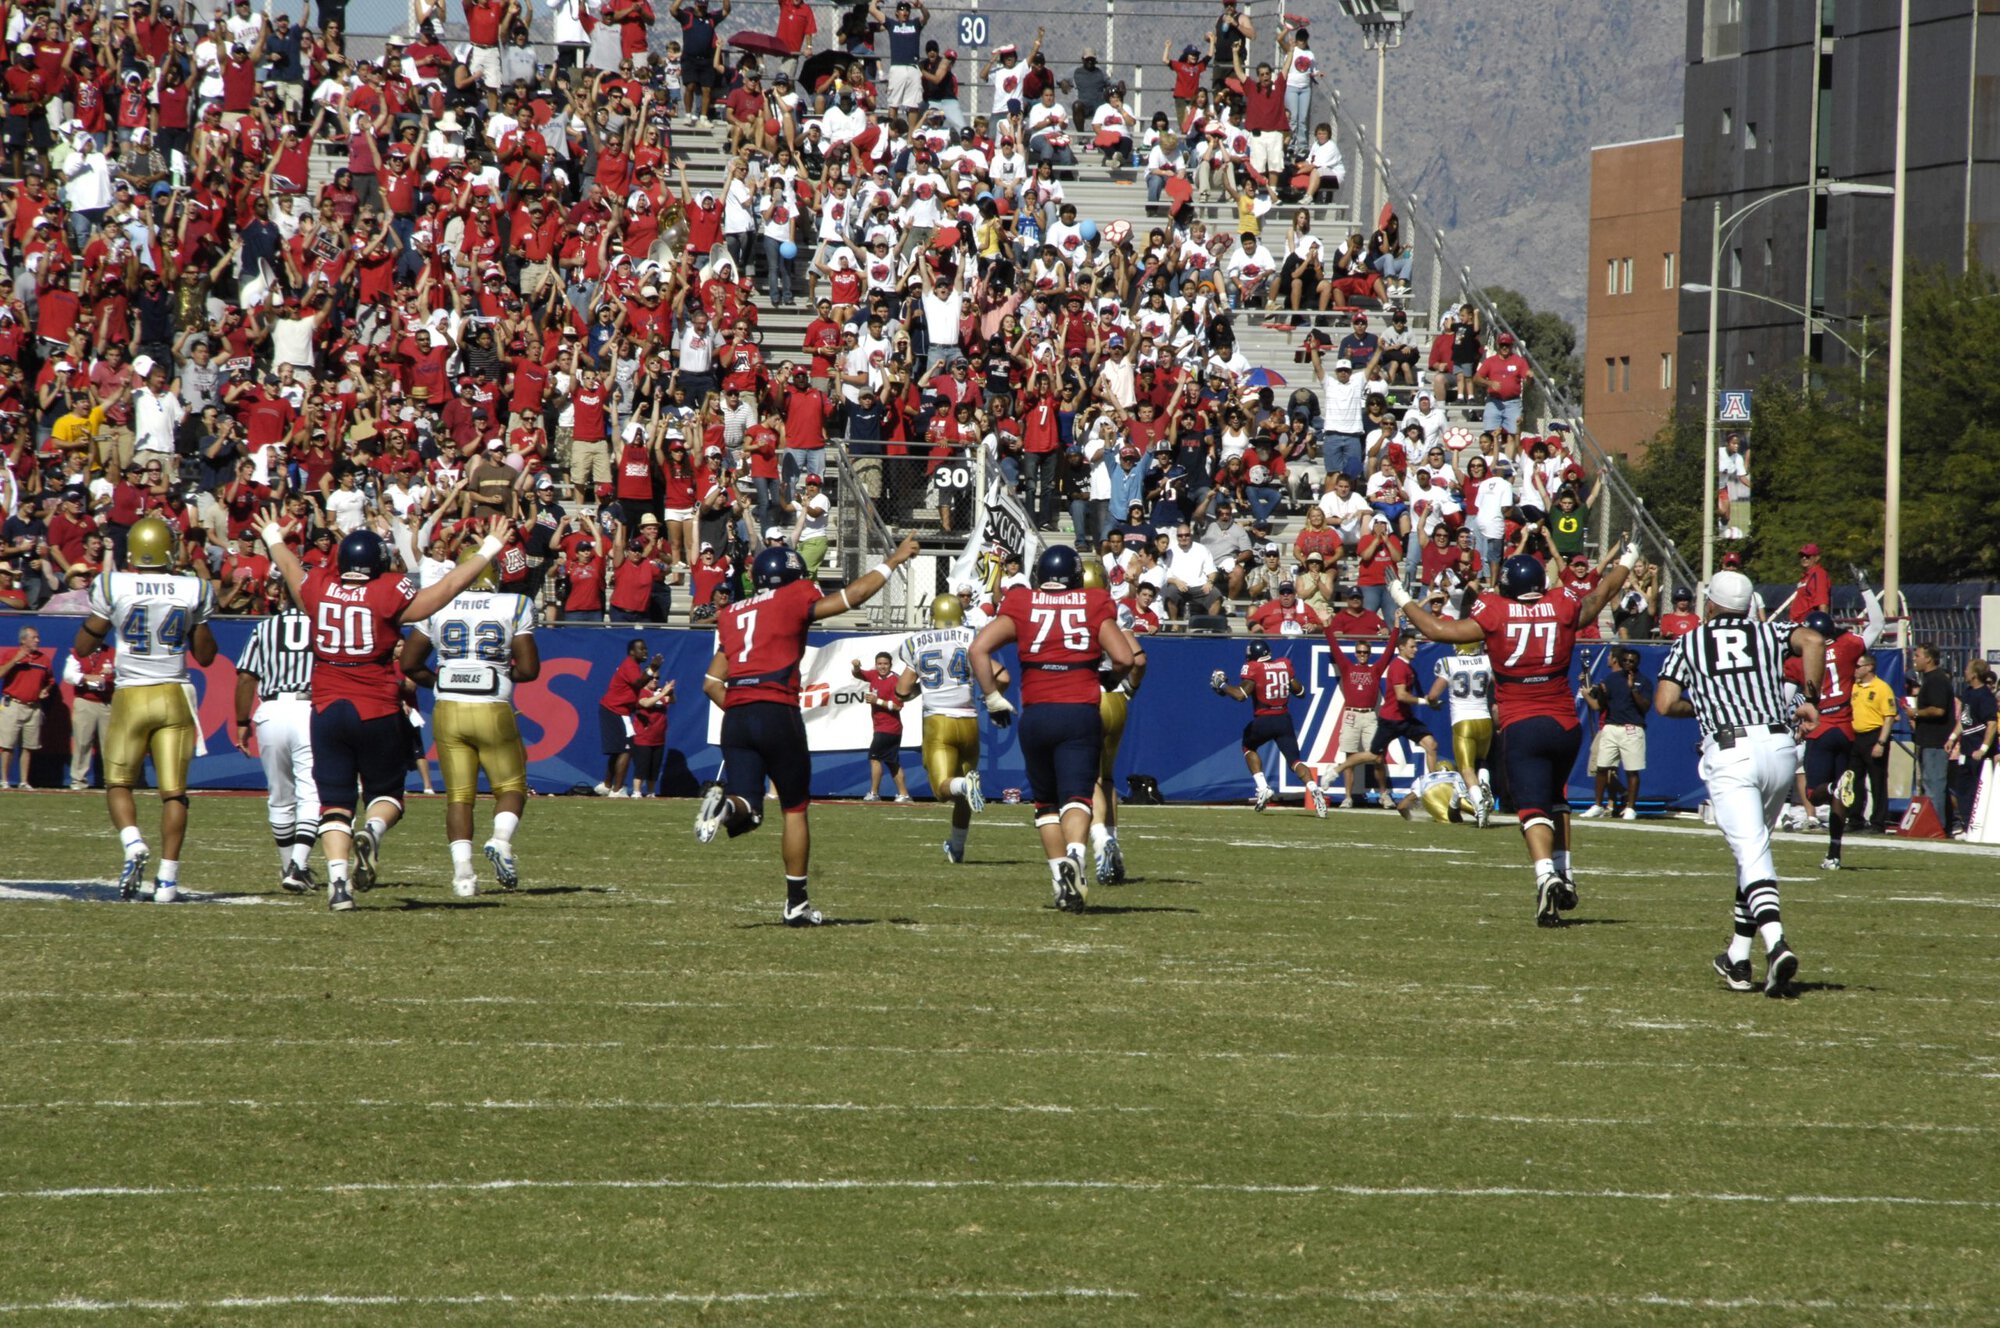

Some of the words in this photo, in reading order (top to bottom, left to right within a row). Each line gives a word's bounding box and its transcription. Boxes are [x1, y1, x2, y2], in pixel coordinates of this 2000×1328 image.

[961, 16, 986, 44] 30
[1039, 405, 1048, 425] 7
[1720, 392, 1750, 421] A
[935, 467, 969, 488] 30
[136, 582, 175, 595] DAVIS
[454, 598, 491, 610] PRICE
[122, 604, 188, 655] 44
[283, 615, 311, 651] U
[316, 602, 374, 655] 50
[441, 619, 505, 663] 92
[736, 609, 758, 663] 7
[916, 629, 970, 647] BOSWORTH
[1030, 608, 1091, 653] 75
[1504, 621, 1558, 667] 77
[1712, 628, 1754, 671] R
[450, 673, 481, 684] DOUGLAS
[919, 647, 973, 690] 54
[834, 691, 865, 705] ON
[1265, 671, 1290, 700] 28
[1452, 670, 1490, 699] 33
[1900, 802, 1921, 830] G
